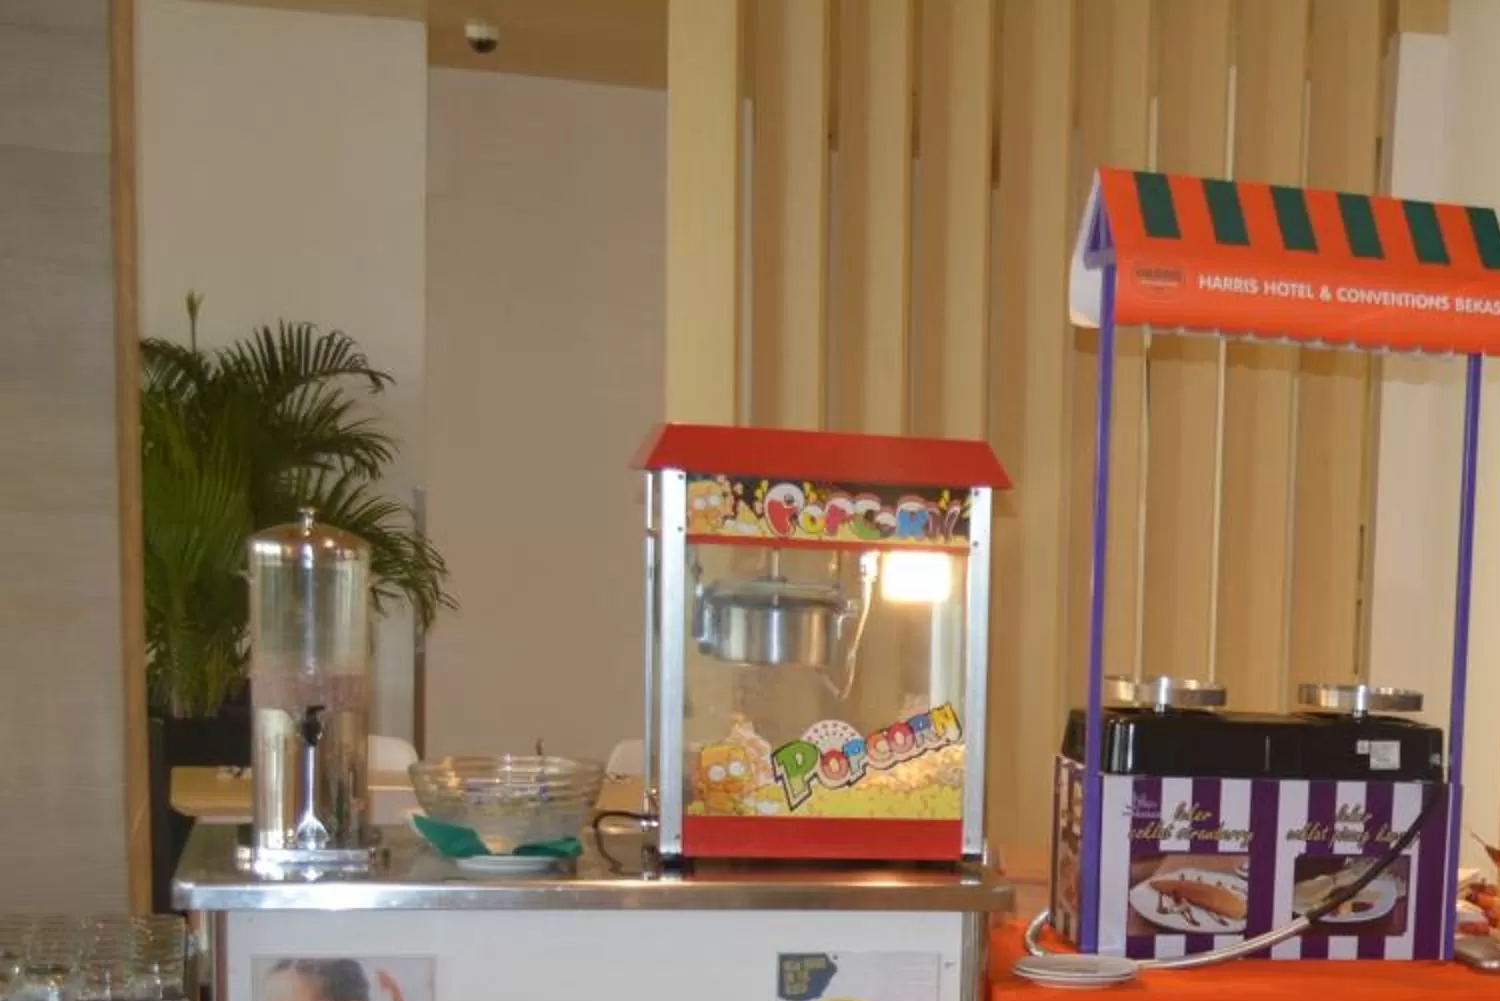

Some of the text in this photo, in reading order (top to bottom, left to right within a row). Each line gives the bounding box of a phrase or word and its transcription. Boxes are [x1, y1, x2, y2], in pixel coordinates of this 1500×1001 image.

[1199, 274, 1259, 295] HARRIS
[1263, 279, 1315, 299] HOTEL
[1320, 284, 1332, 302] &
[1337, 287, 1449, 311] CONVENTIONS
